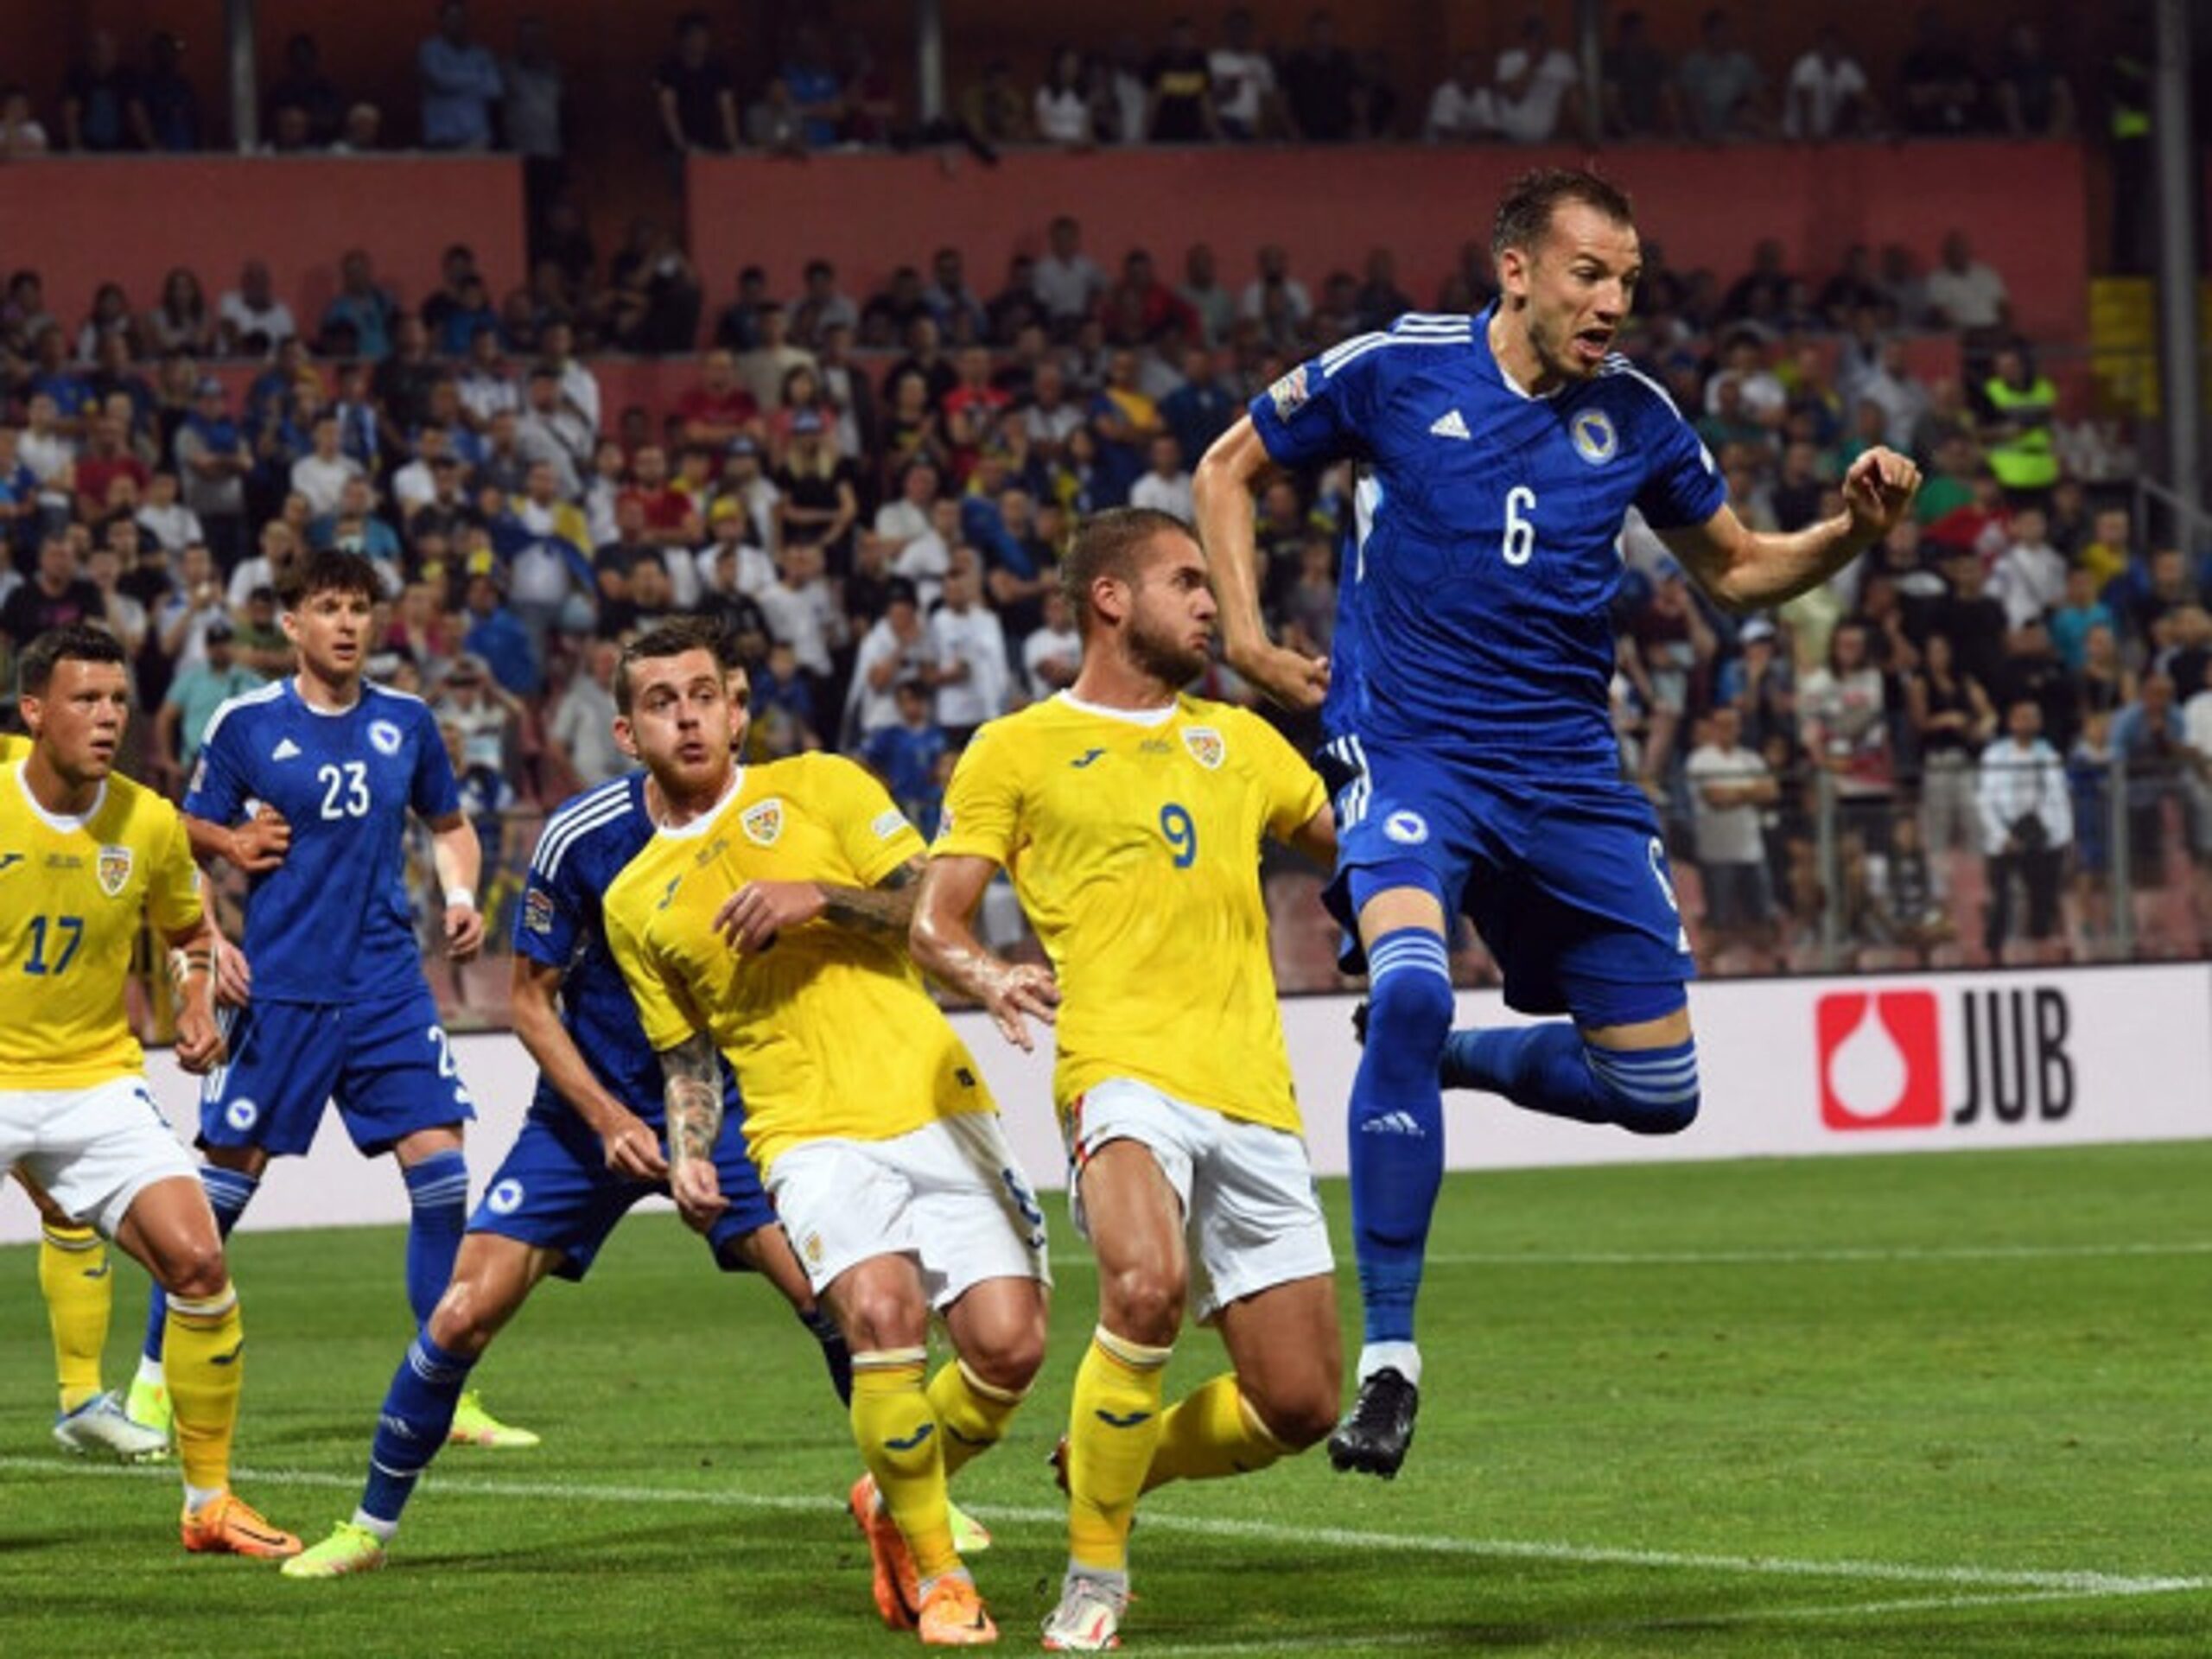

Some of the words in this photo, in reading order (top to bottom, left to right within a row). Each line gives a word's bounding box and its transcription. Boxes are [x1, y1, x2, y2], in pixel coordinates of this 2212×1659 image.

[1503, 486, 1535, 565] 6
[317, 762, 369, 820] 23
[1160, 804, 1197, 868] 9
[24, 915, 84, 976] 17
[1953, 986, 2075, 1128] JUB
